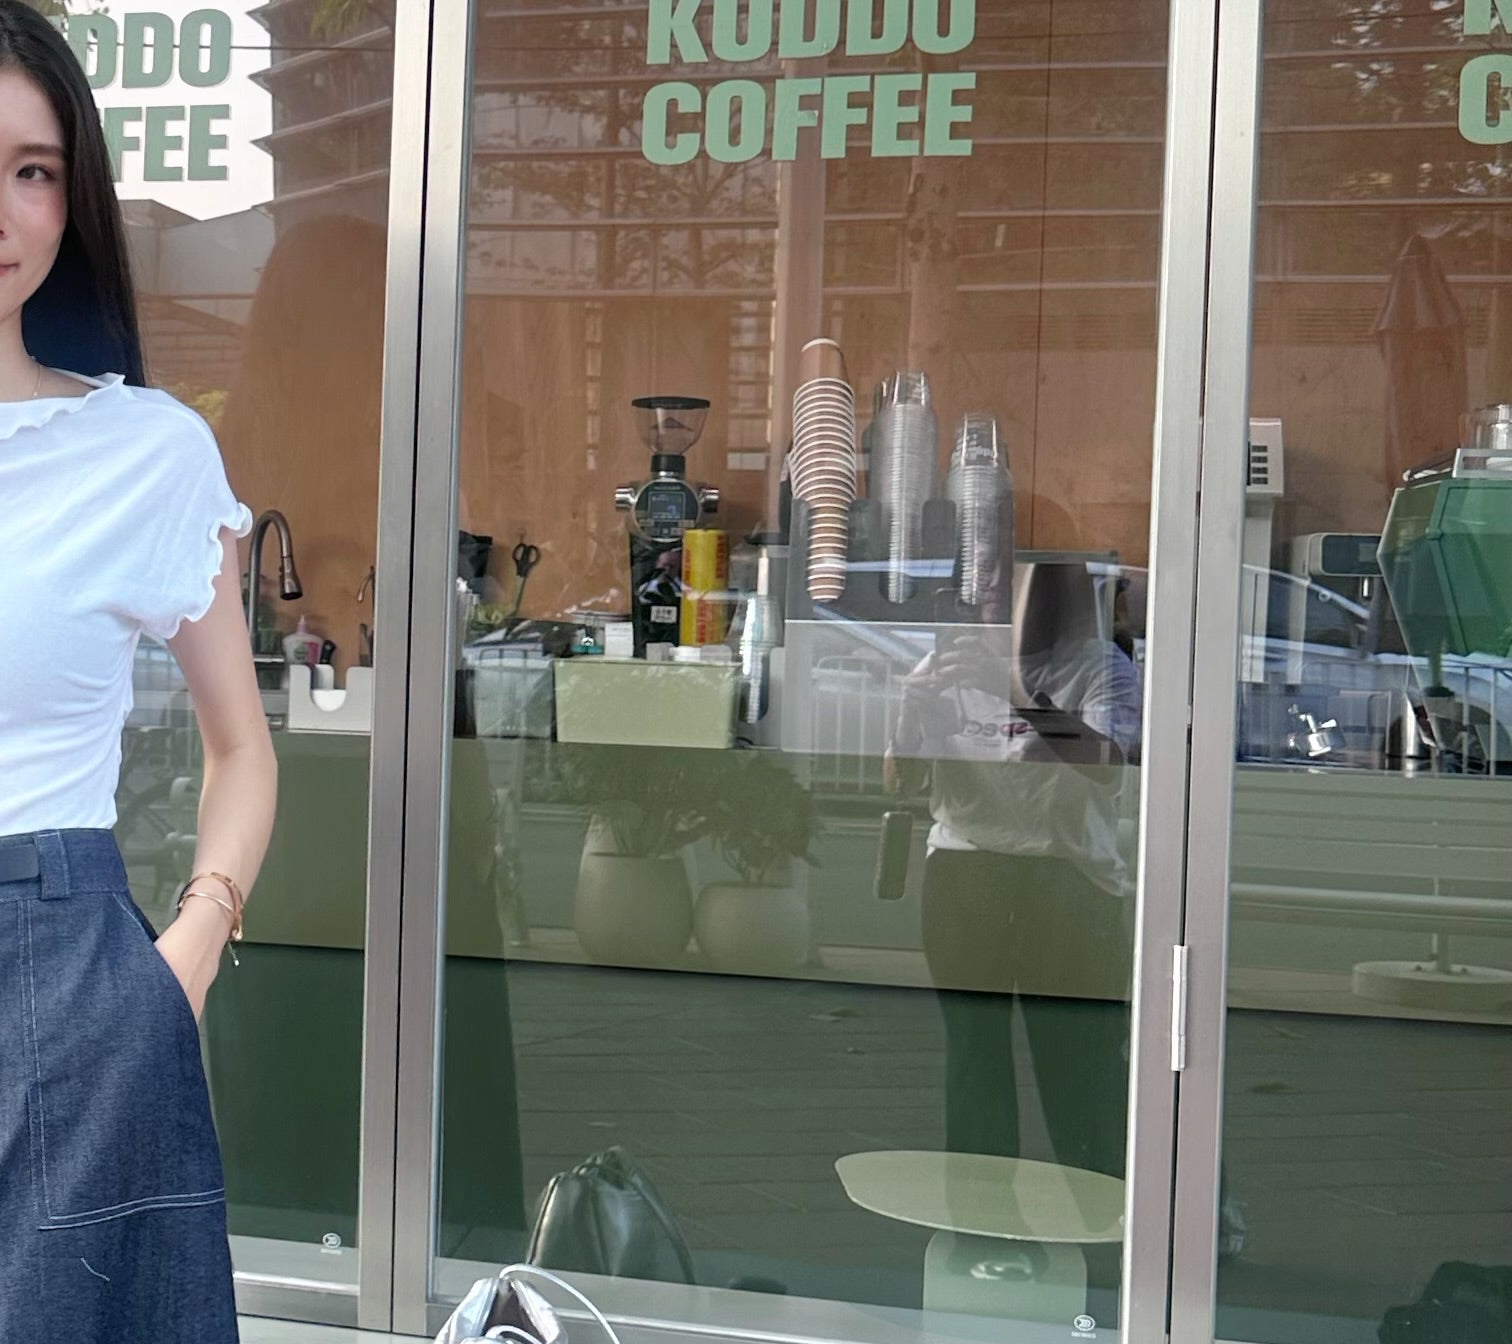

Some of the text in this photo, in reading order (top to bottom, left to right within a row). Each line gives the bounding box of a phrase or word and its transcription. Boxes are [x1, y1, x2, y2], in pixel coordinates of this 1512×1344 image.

[52, 8, 232, 90] DDO
[99, 104, 231, 183] FEE
[641, 72, 976, 165] COFFEE
